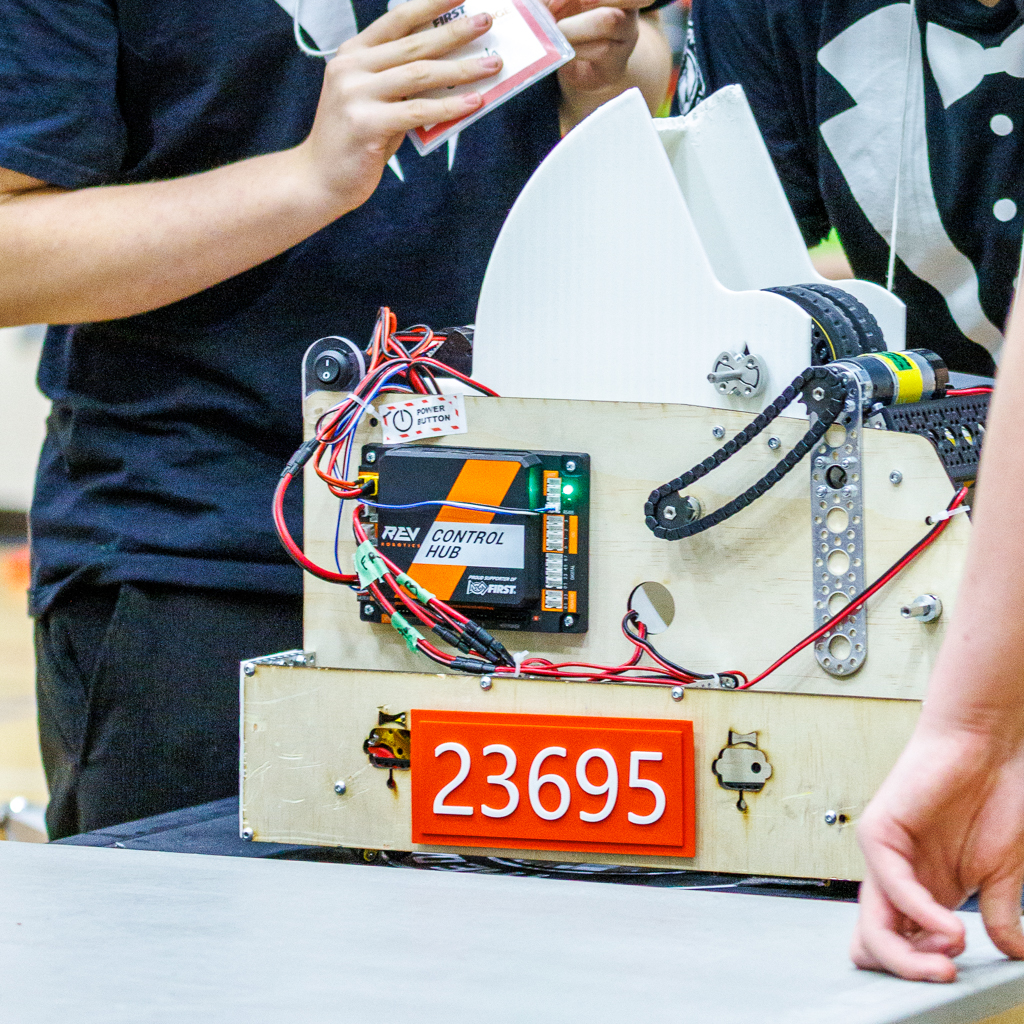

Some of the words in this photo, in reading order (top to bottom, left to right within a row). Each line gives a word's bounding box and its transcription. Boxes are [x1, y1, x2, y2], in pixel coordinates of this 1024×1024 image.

[431, 4, 465, 28] FIRST
[416, 404, 446, 417] POWER
[416, 414, 451, 426] BUTTON
[381, 525, 421, 542] REV
[431, 529, 505, 545] CONTROL
[425, 545, 462, 559] HUB
[433, 741, 667, 826] 23695
